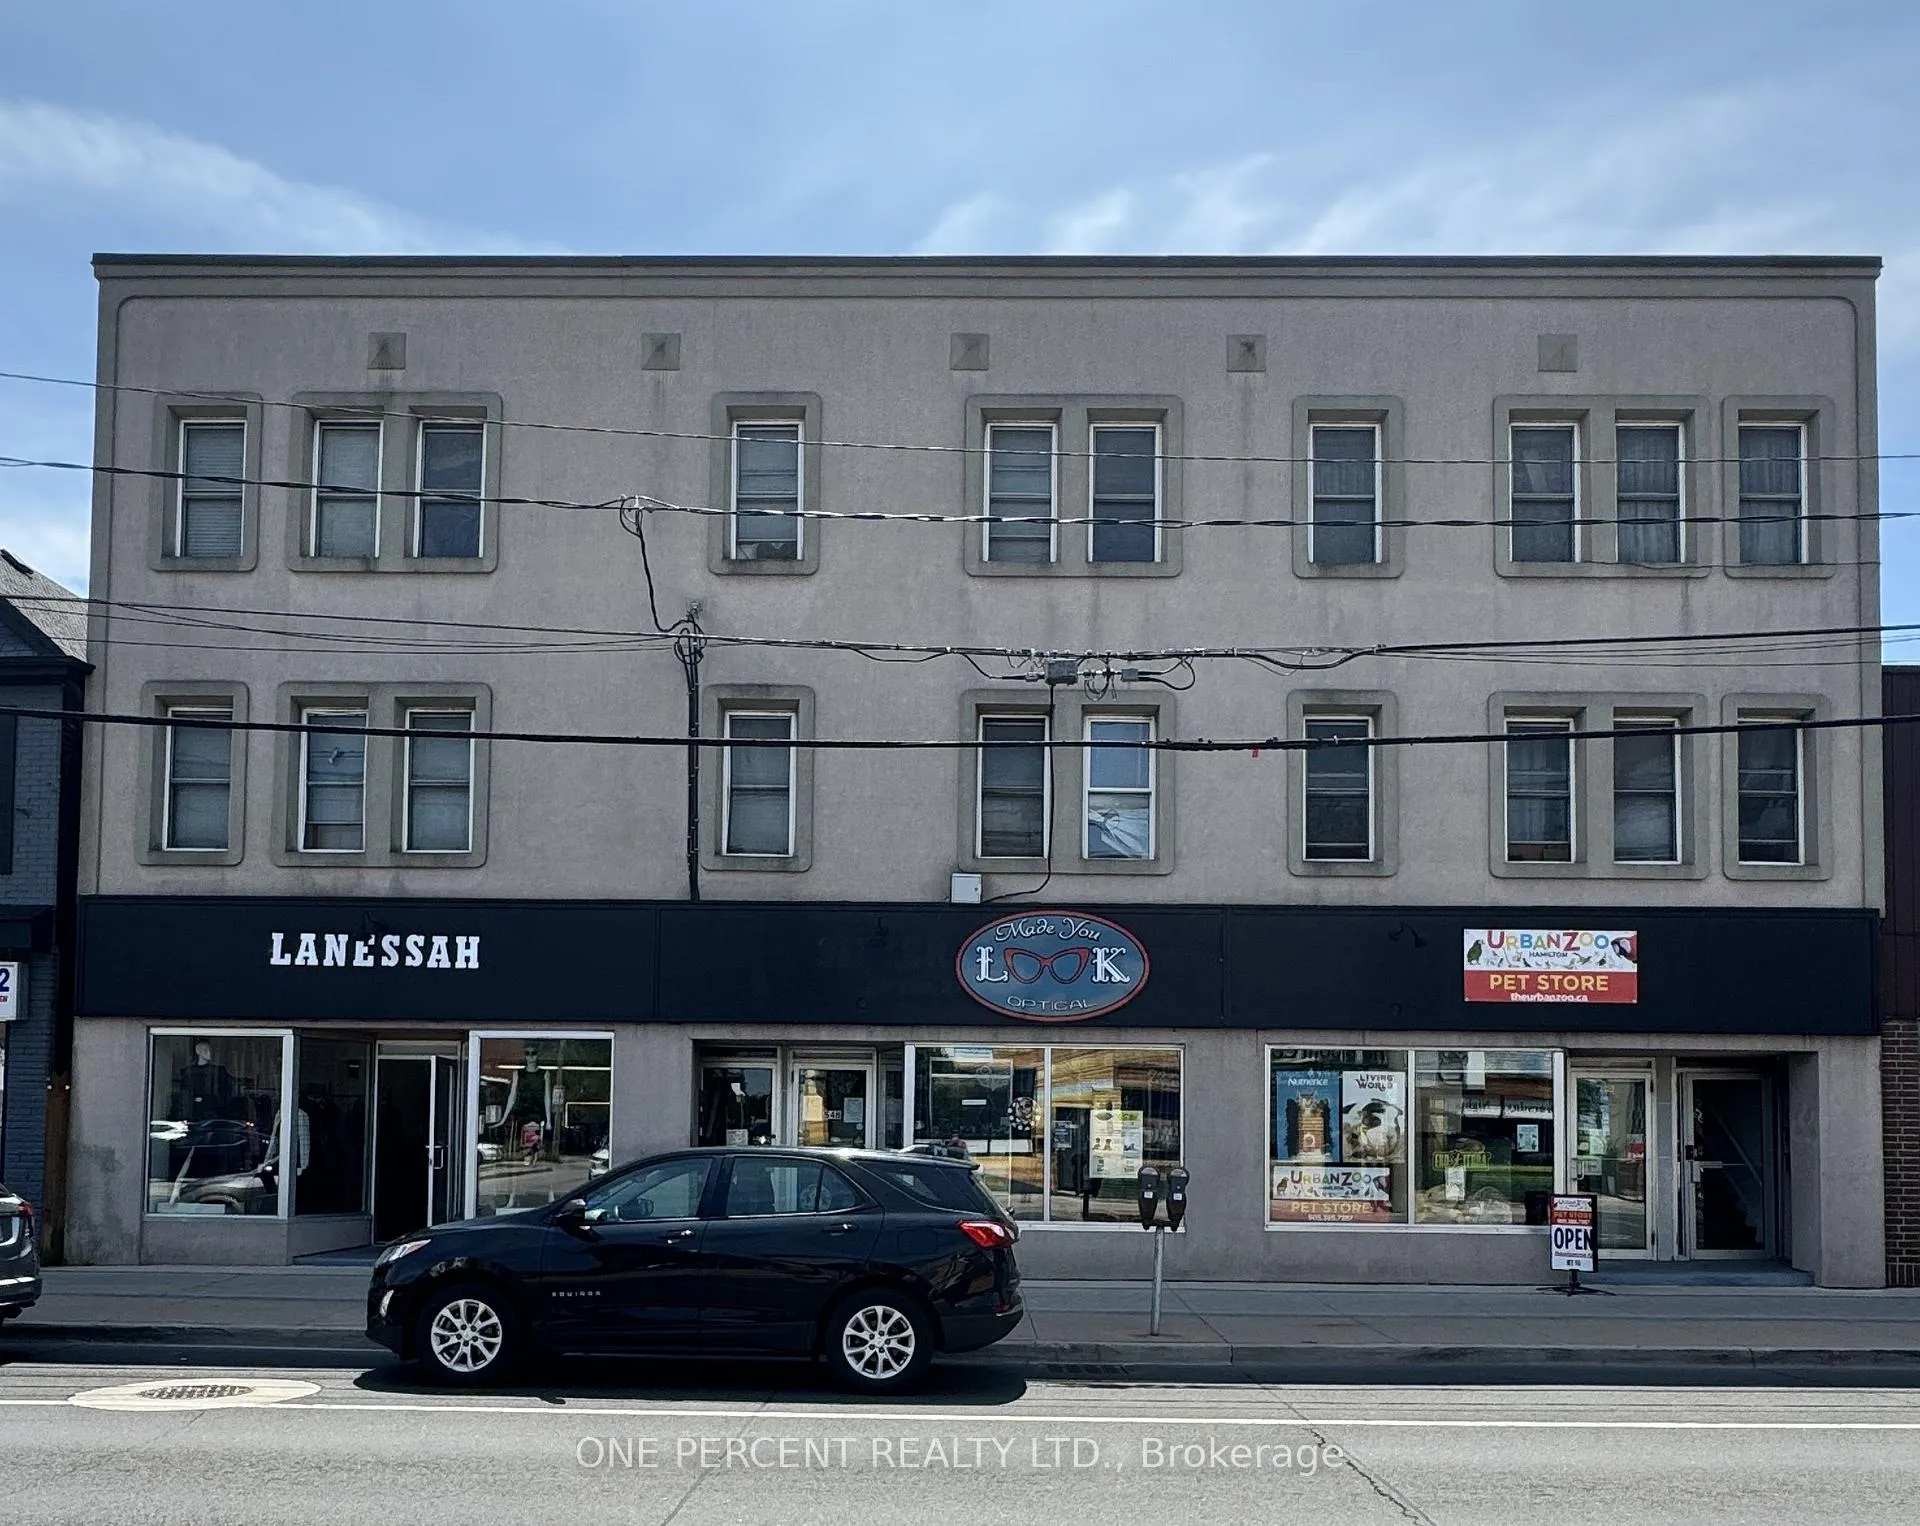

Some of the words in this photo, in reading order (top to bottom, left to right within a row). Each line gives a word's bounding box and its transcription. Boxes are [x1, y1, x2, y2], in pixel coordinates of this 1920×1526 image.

[995, 917, 1056, 941] Made
[1059, 917, 1101, 941] You
[270, 932, 480, 969] LANESSAH
[1489, 974, 1530, 991] PET
[1537, 974, 1609, 991] STORE
[1007, 995, 1098, 1011] OPTICAL
[1356, 1079, 1393, 1092] WORLD
[1360, 1074, 1393, 1082] LIVING
[1291, 1201, 1320, 1213] PET
[1322, 1202, 1372, 1214] STORE
[1554, 1227, 1594, 1250] OPEN
